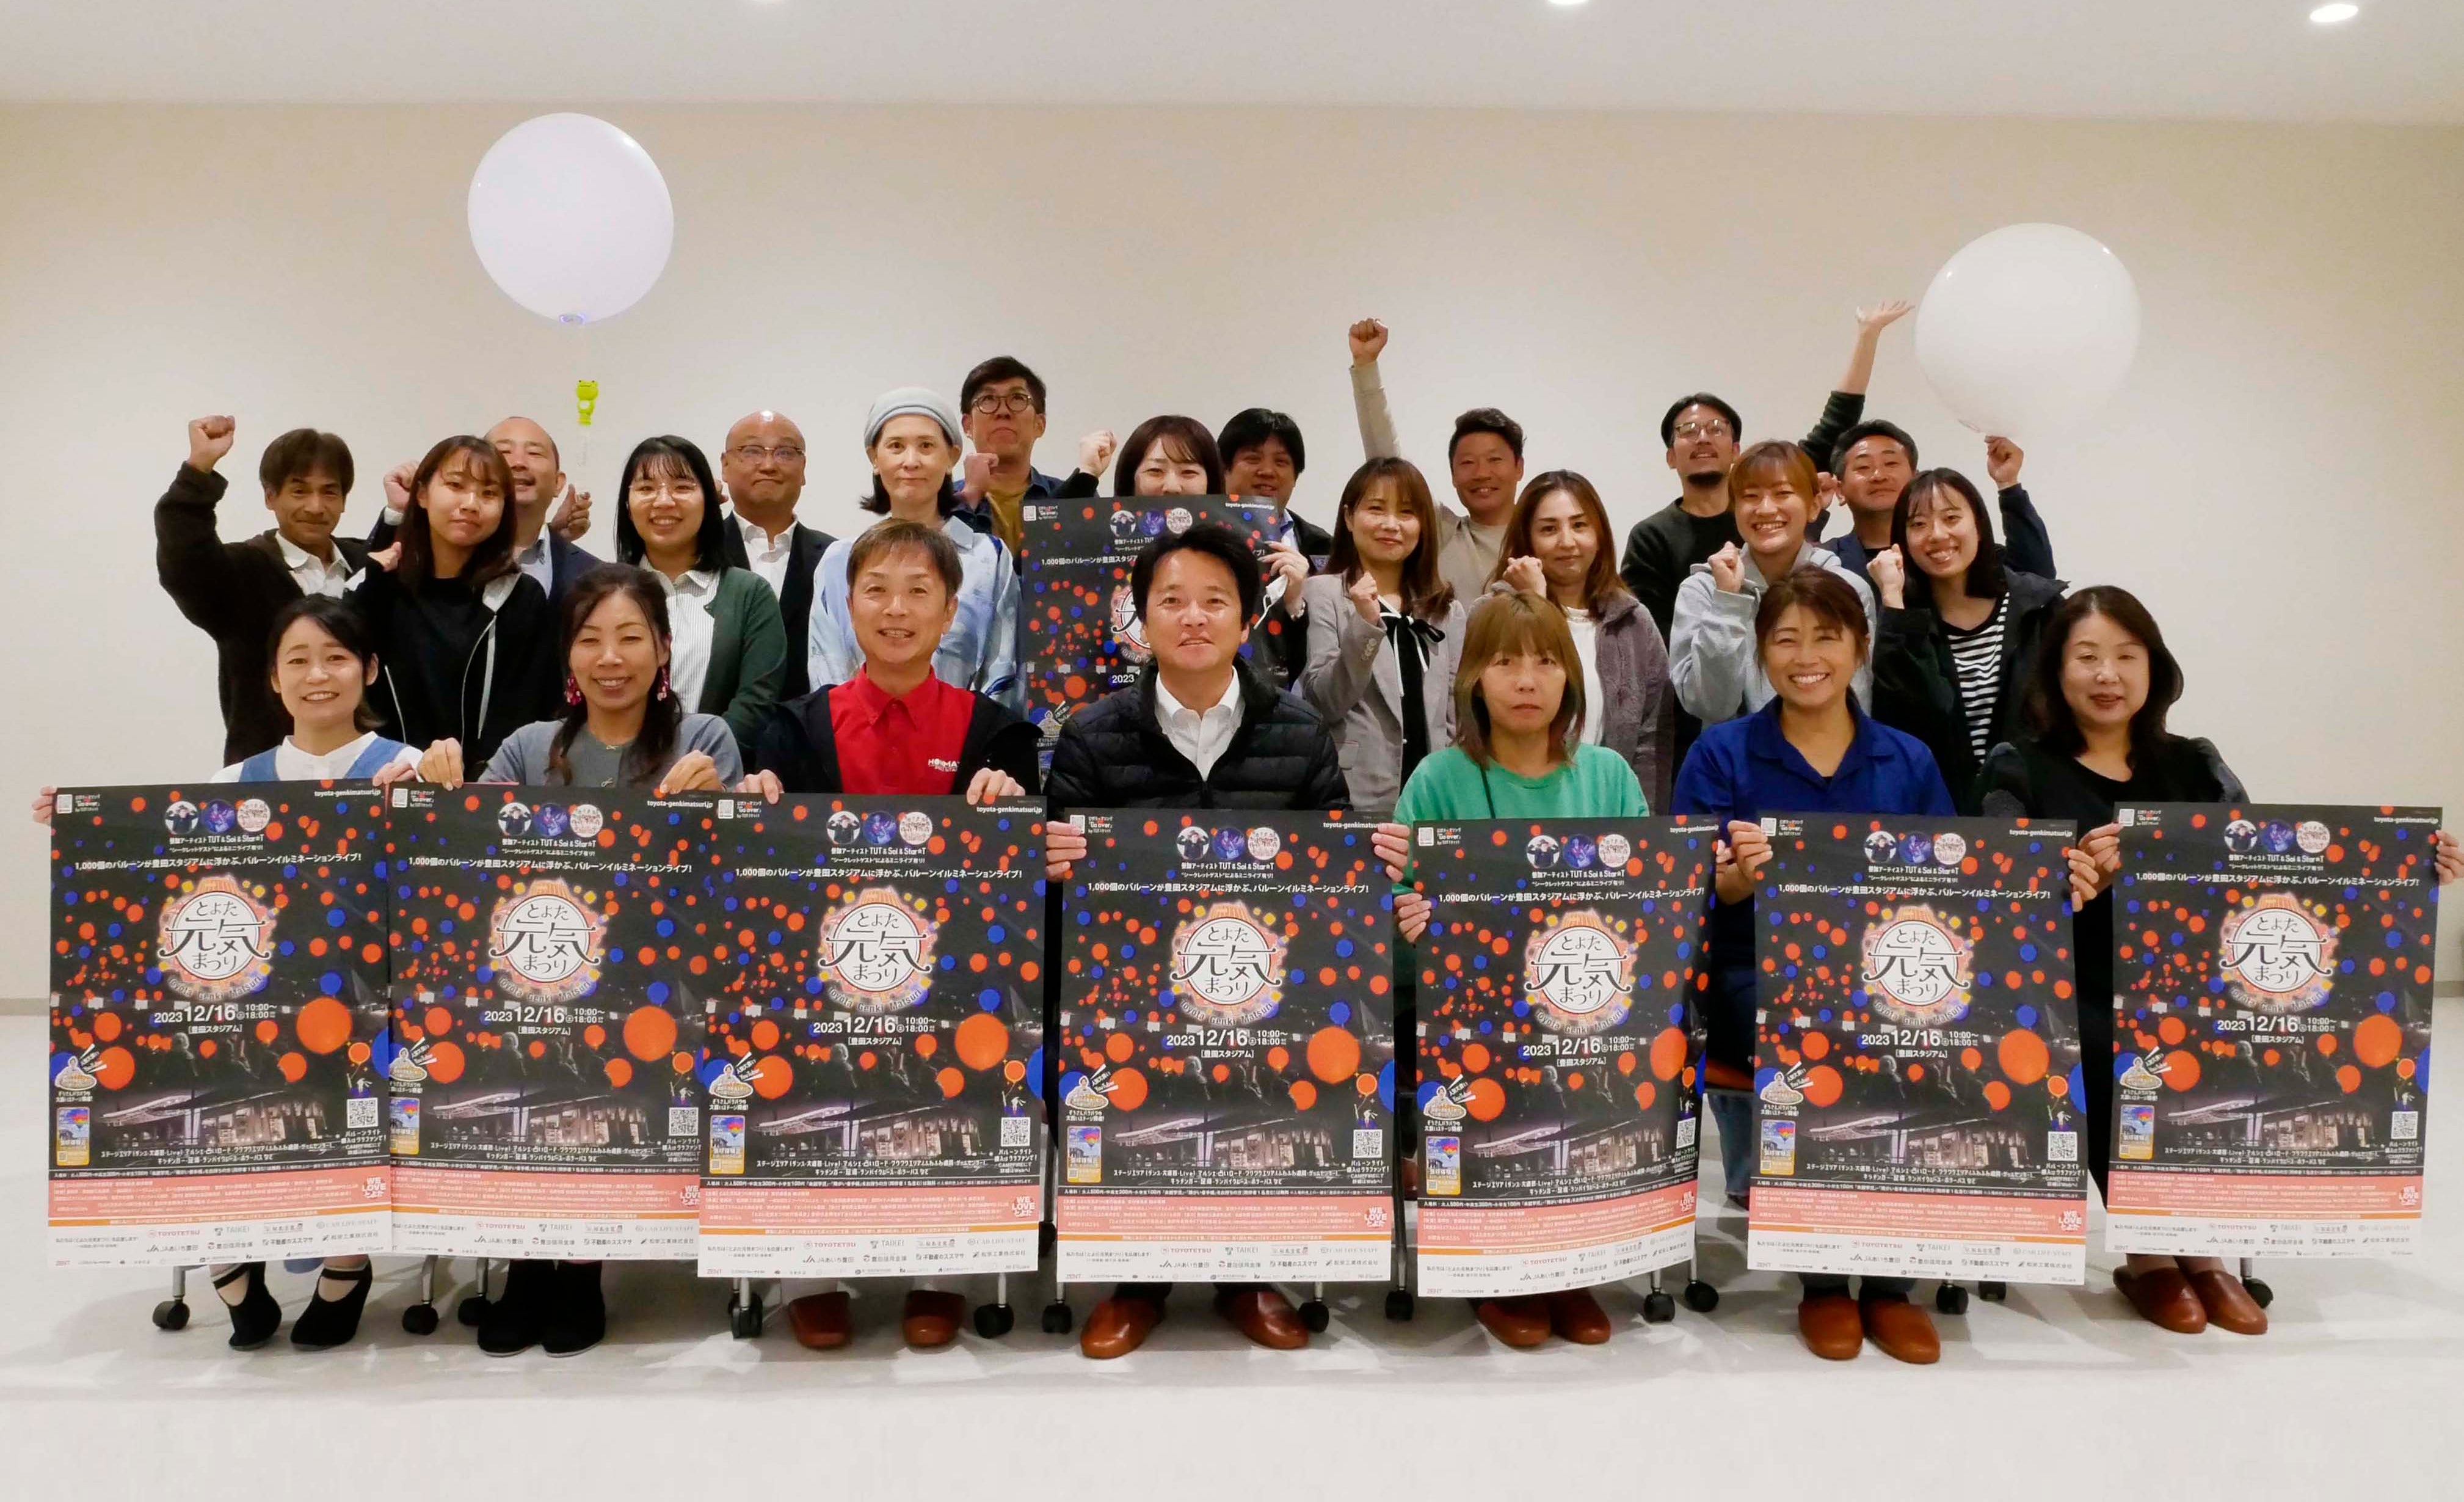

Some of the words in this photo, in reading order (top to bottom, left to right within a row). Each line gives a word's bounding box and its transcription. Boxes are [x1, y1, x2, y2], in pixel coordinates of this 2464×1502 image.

[1112, 674, 1135, 684] 2023
[196, 900, 239, 917] とよた
[527, 904, 570, 921] とよた
[857, 912, 901, 928] とよた
[2256, 916, 2300, 933] とよた
[159, 914, 270, 961] 元気
[490, 918, 601, 964] 元気
[1208, 927, 1249, 942] とよた
[1561, 934, 1602, 951] とよた
[1895, 929, 1936, 945] とよた
[820, 927, 931, 972] 元気
[2220, 931, 2331, 974] 元気
[192, 951, 236, 972] まつり
[522, 954, 566, 974] まつり
[1171, 942, 1281, 985] 元気
[1861, 944, 1969, 987] 元気
[852, 963, 897, 983] まつり
[1524, 948, 1631, 995] 元気
[2253, 966, 2298, 985] まつり
[528, 992, 553, 1002] Genki
[558, 979, 592, 1001] Matsuri
[1204, 977, 1248, 996] まつり
[1558, 985, 1601, 1006] まつり
[1895, 978, 1938, 998] まつり
[829, 987, 852, 1007] Toyota
[857, 1002, 884, 1012] Genki
[889, 989, 922, 1010] Matsuri
[154, 1011, 183, 1023] 2023
[184, 1004, 236, 1022] 12/16
[484, 1010, 512, 1022] 2023
[513, 1005, 565, 1023] 12/16
[1181, 1000, 1205, 1020] Toyota
[1210, 1016, 1236, 1025] Genki
[1241, 1002, 1273, 1023] Matsuri
[813, 1022, 842, 1033] 2023
[843, 1016, 896, 1033] 12/16
[2217, 1020, 2245, 1030] 2023
[2247, 1015, 2298, 1032] 12/16
[1166, 1035, 1195, 1046] 2023
[1196, 1029, 1248, 1046] 12/16
[1523, 1044, 1550, 1056] 2023
[1552, 1037, 1601, 1055] 12/16
[1861, 1034, 1889, 1045] 2023
[1891, 1029, 1941, 1046] 12/16
[1608, 1043, 1629, 1052] 18:00
[362, 1182, 387, 1192] LOVE
[1011, 1201, 1036, 1211] LOVE
[2058, 1216, 2082, 1225] LOVE
